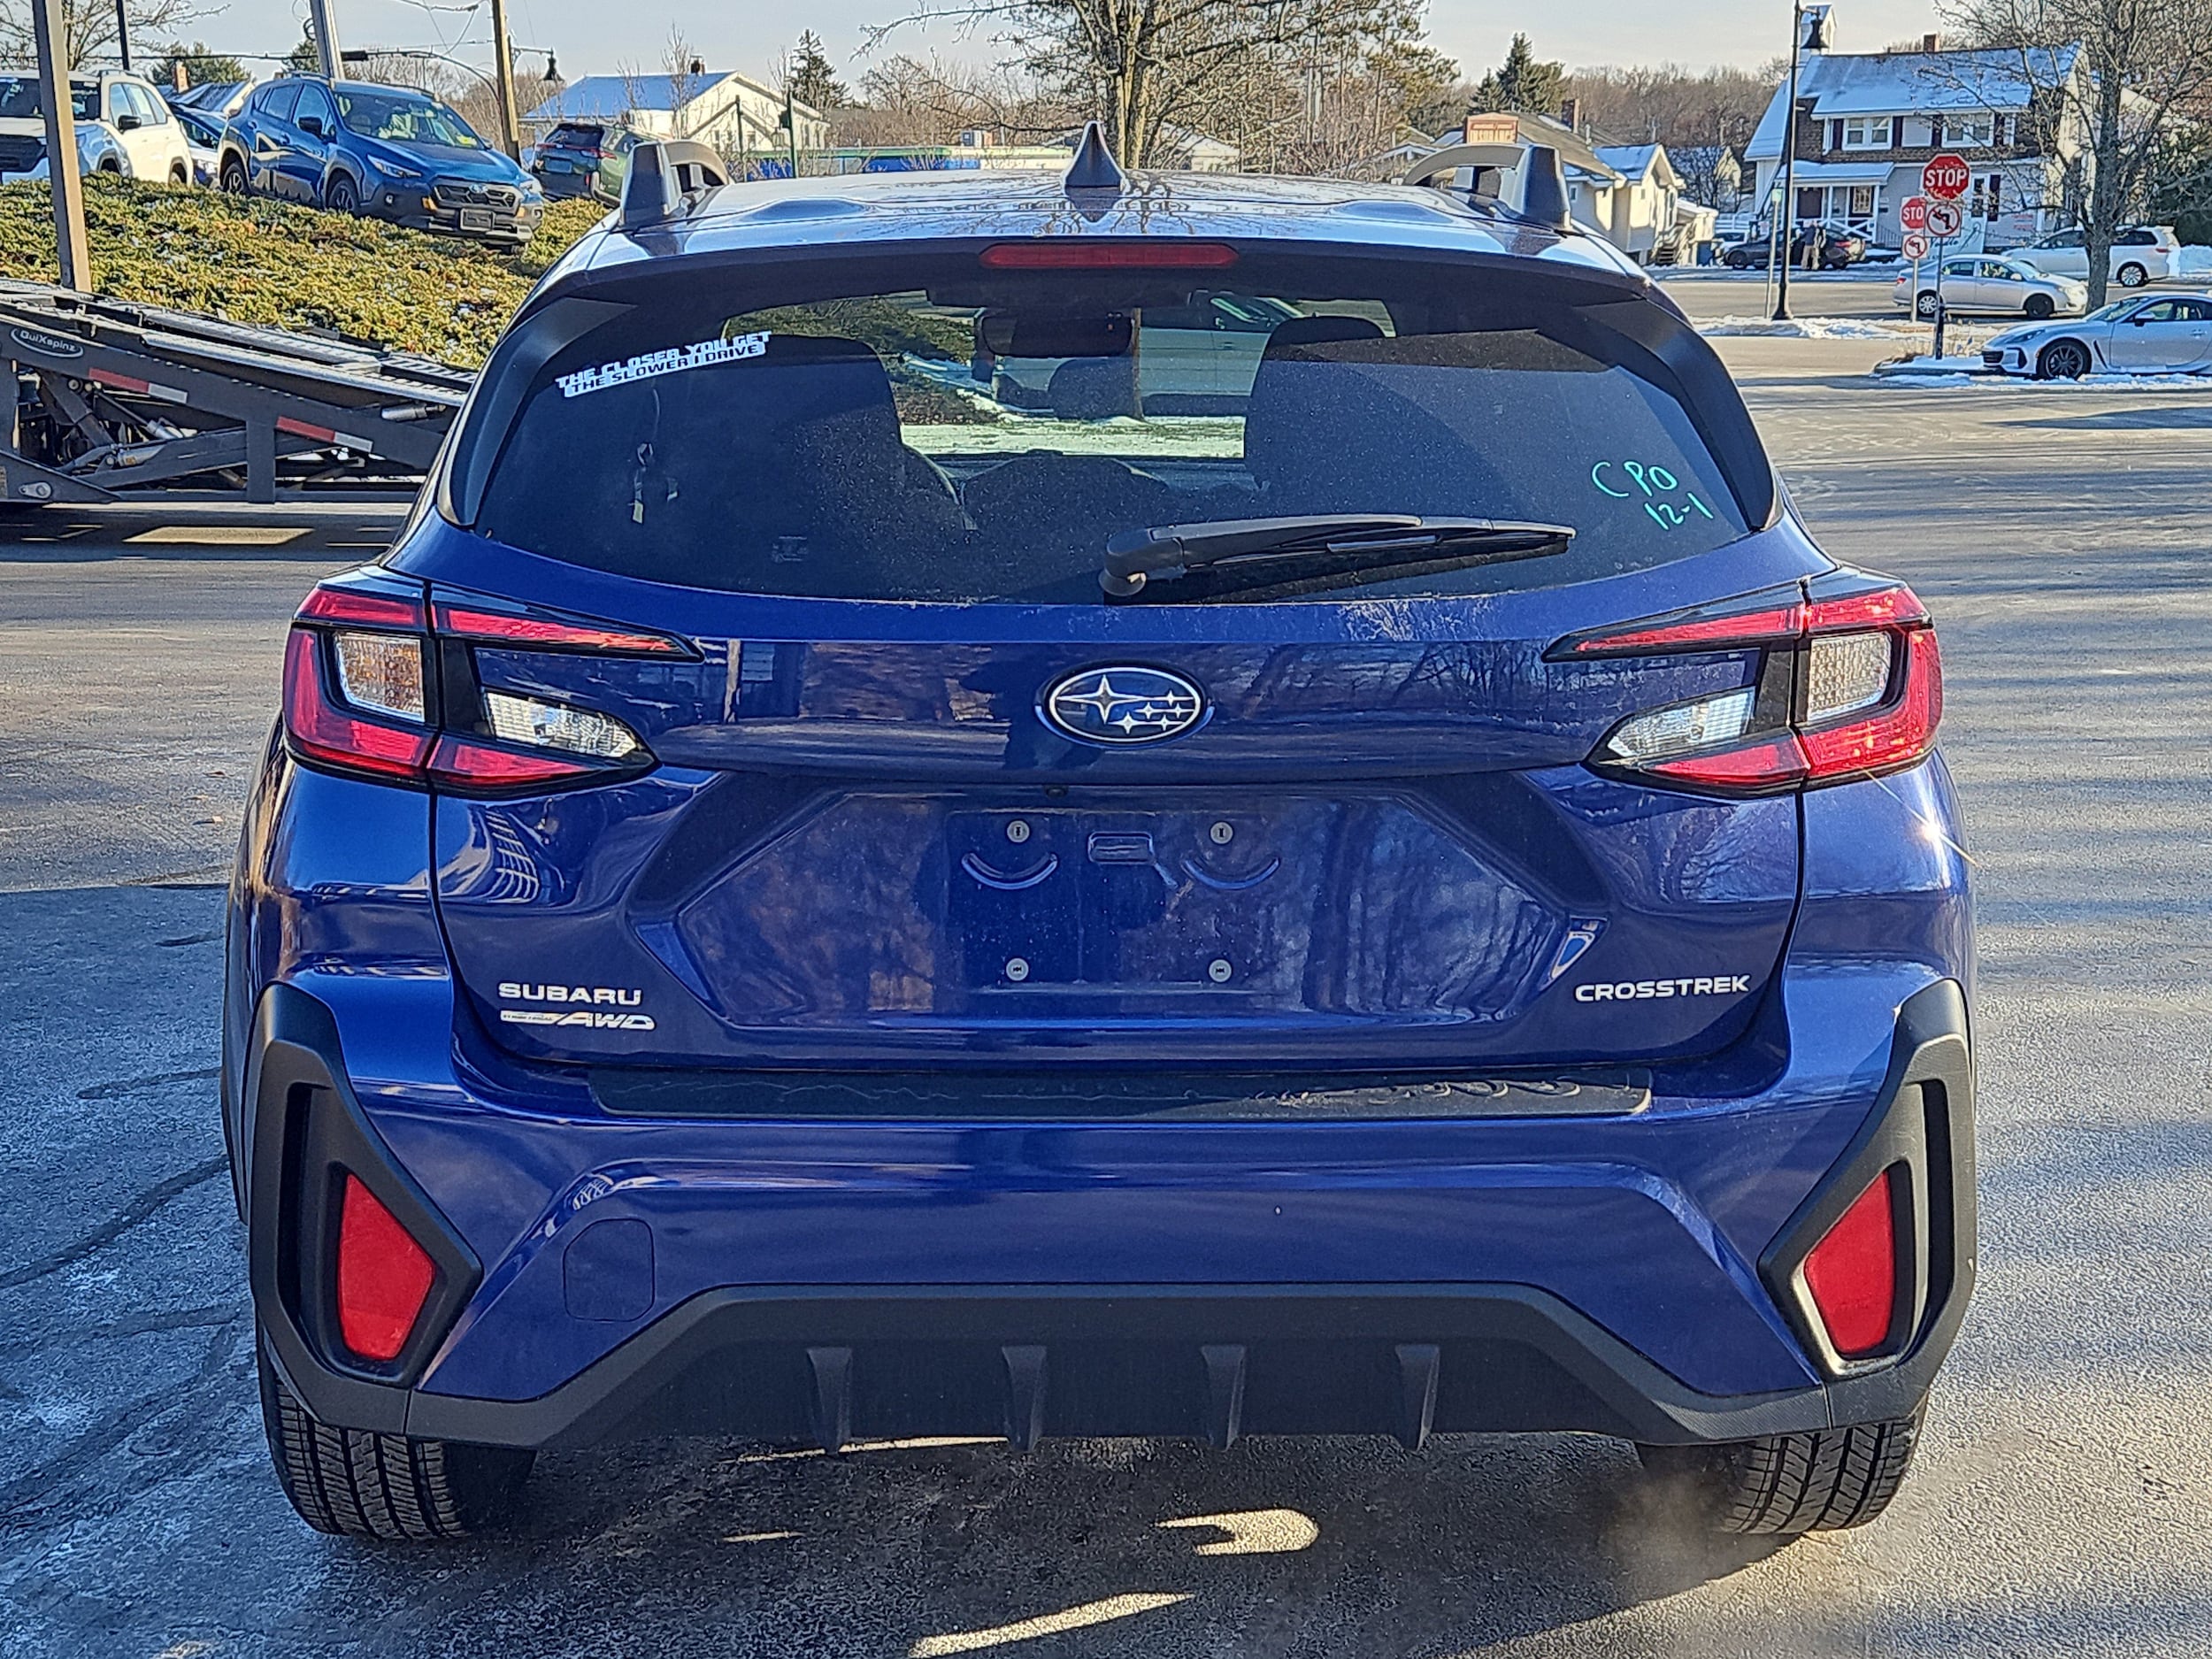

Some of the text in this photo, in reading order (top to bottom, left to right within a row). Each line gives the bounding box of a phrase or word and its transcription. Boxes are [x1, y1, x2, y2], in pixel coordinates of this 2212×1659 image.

[1925, 168, 1968, 188] STOP
[1902, 206, 1924, 220] STO
[555, 330, 772, 388] THE CLOSER YOU GET
[572, 344, 758, 393] THE SLOWER I DRIVE
[1592, 461, 1678, 497] CPO
[1644, 492, 1714, 531] 12-1
[498, 982, 641, 1005] SUBARU
[1575, 974, 1751, 1002] CROSSTREK
[557, 1011, 656, 1030] AWD
